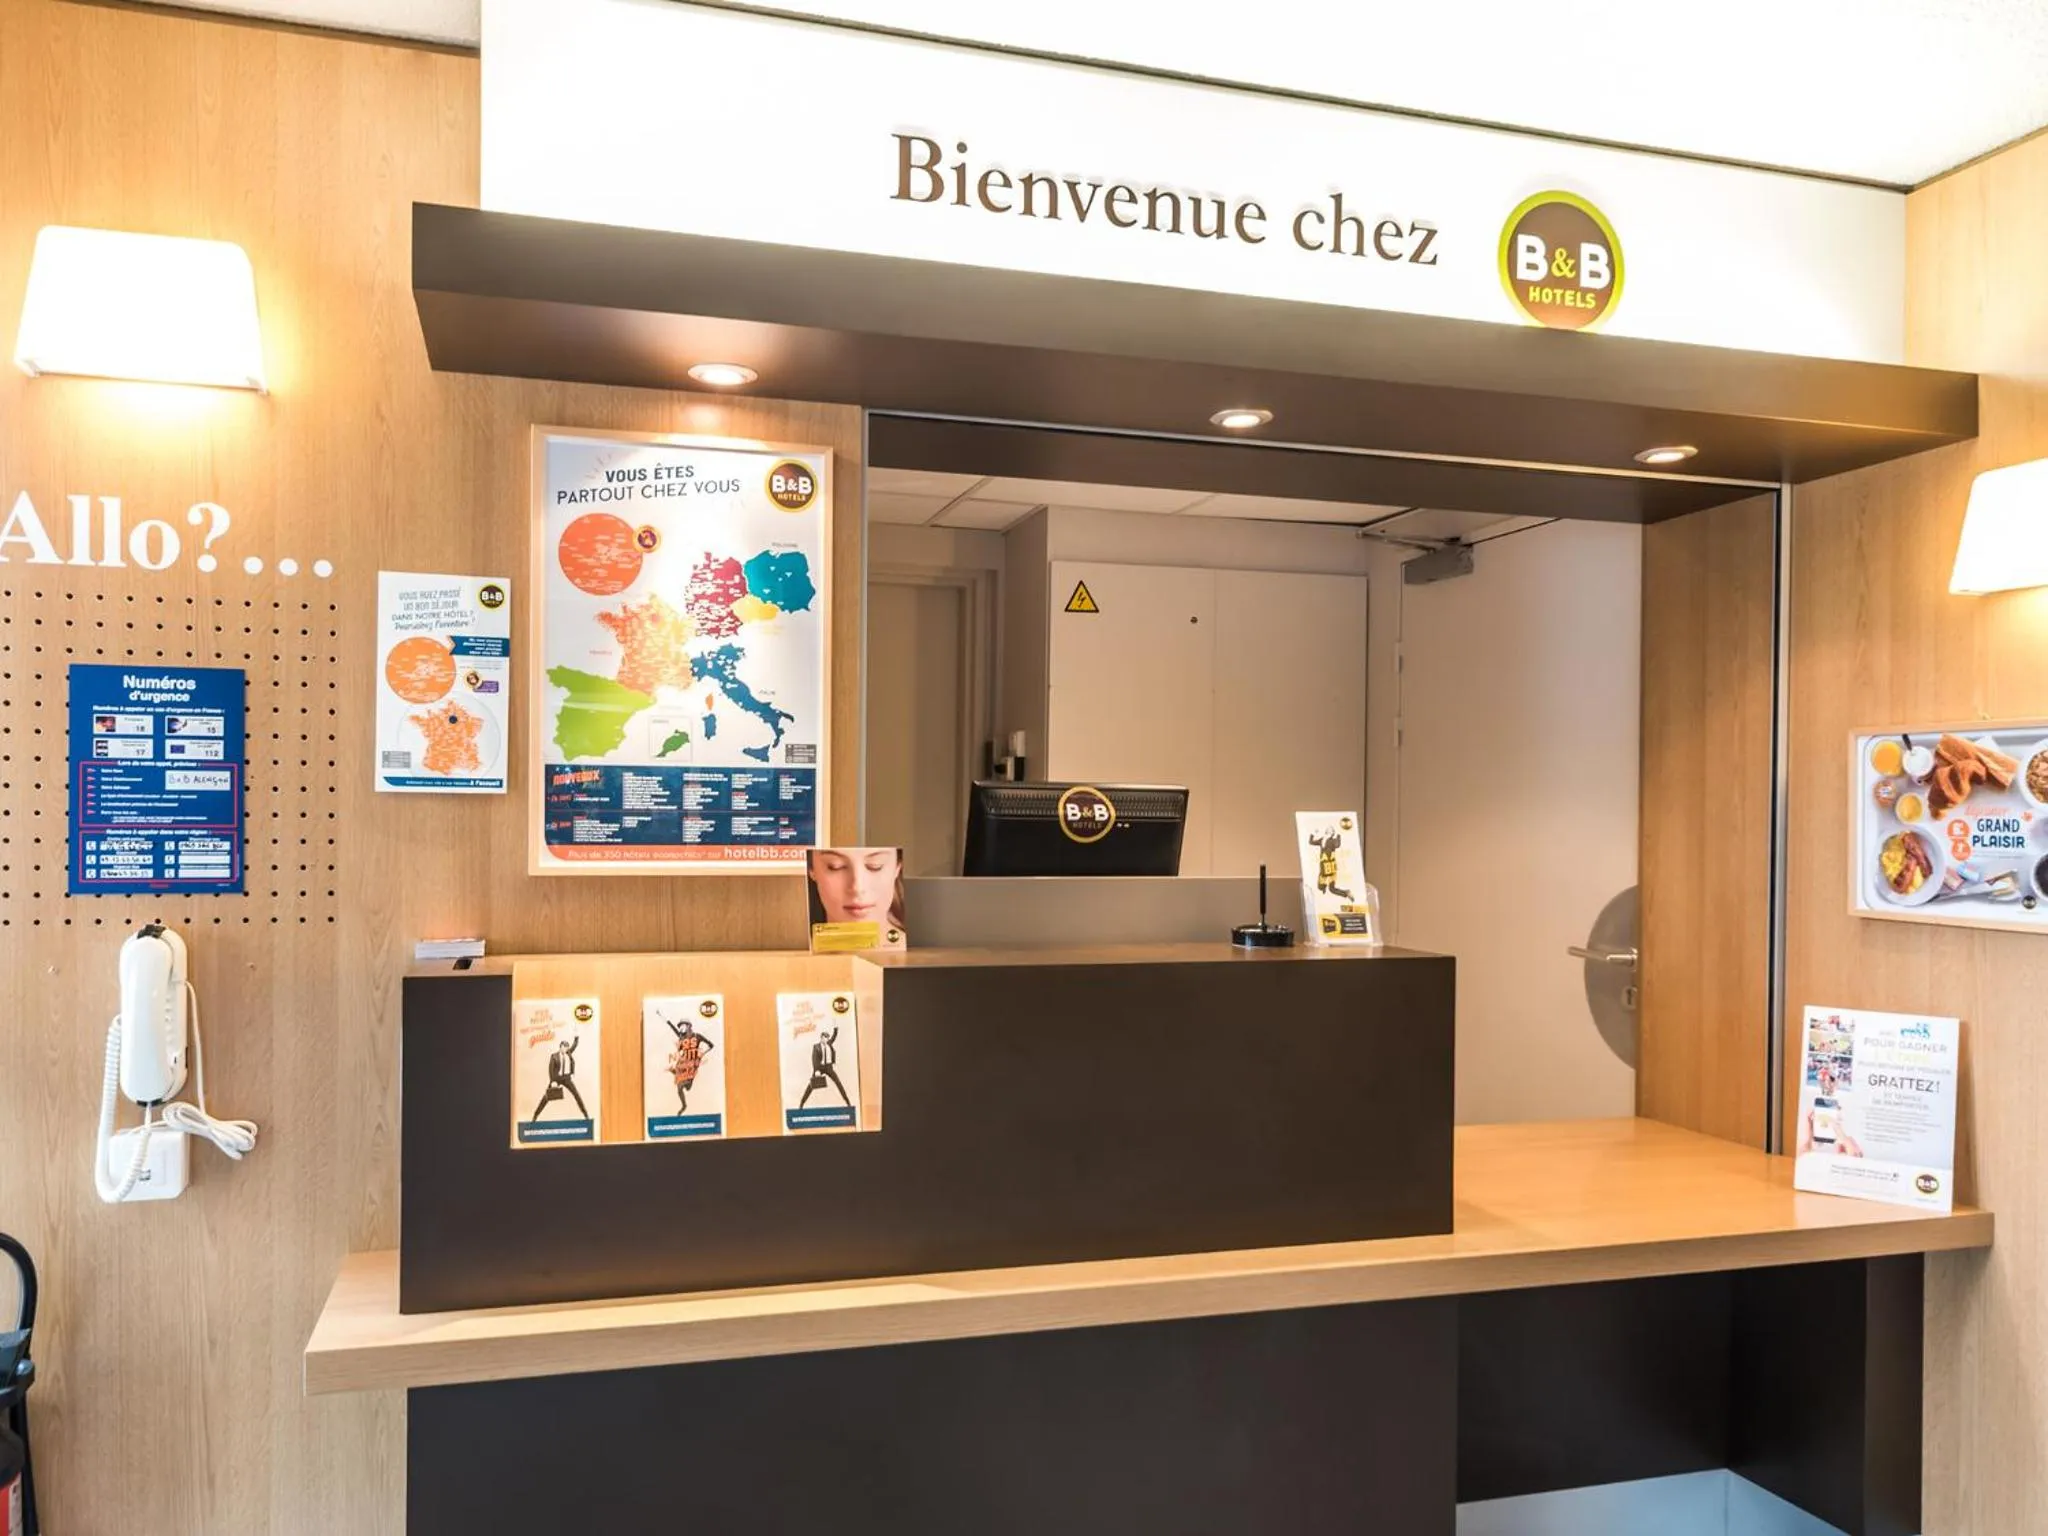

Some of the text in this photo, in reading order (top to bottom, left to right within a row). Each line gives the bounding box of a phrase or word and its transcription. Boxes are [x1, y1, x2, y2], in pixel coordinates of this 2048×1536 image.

[890, 134, 1439, 266] Bienvenue chez
[1516, 233, 1611, 290] B&B
[1528, 286, 1597, 309] HOTELS
[605, 463, 695, 483] VOUS ÊTES
[557, 479, 740, 505] PARTOUT CHEZ VOUS
[777, 492, 807, 501] HOTELS
[123, 675, 196, 690] Numéros
[129, 689, 190, 703] d'urgence
[1066, 803, 1109, 821] B&B
[1977, 818, 2020, 833] GRAND
[1972, 835, 2026, 848] PLAISIR
